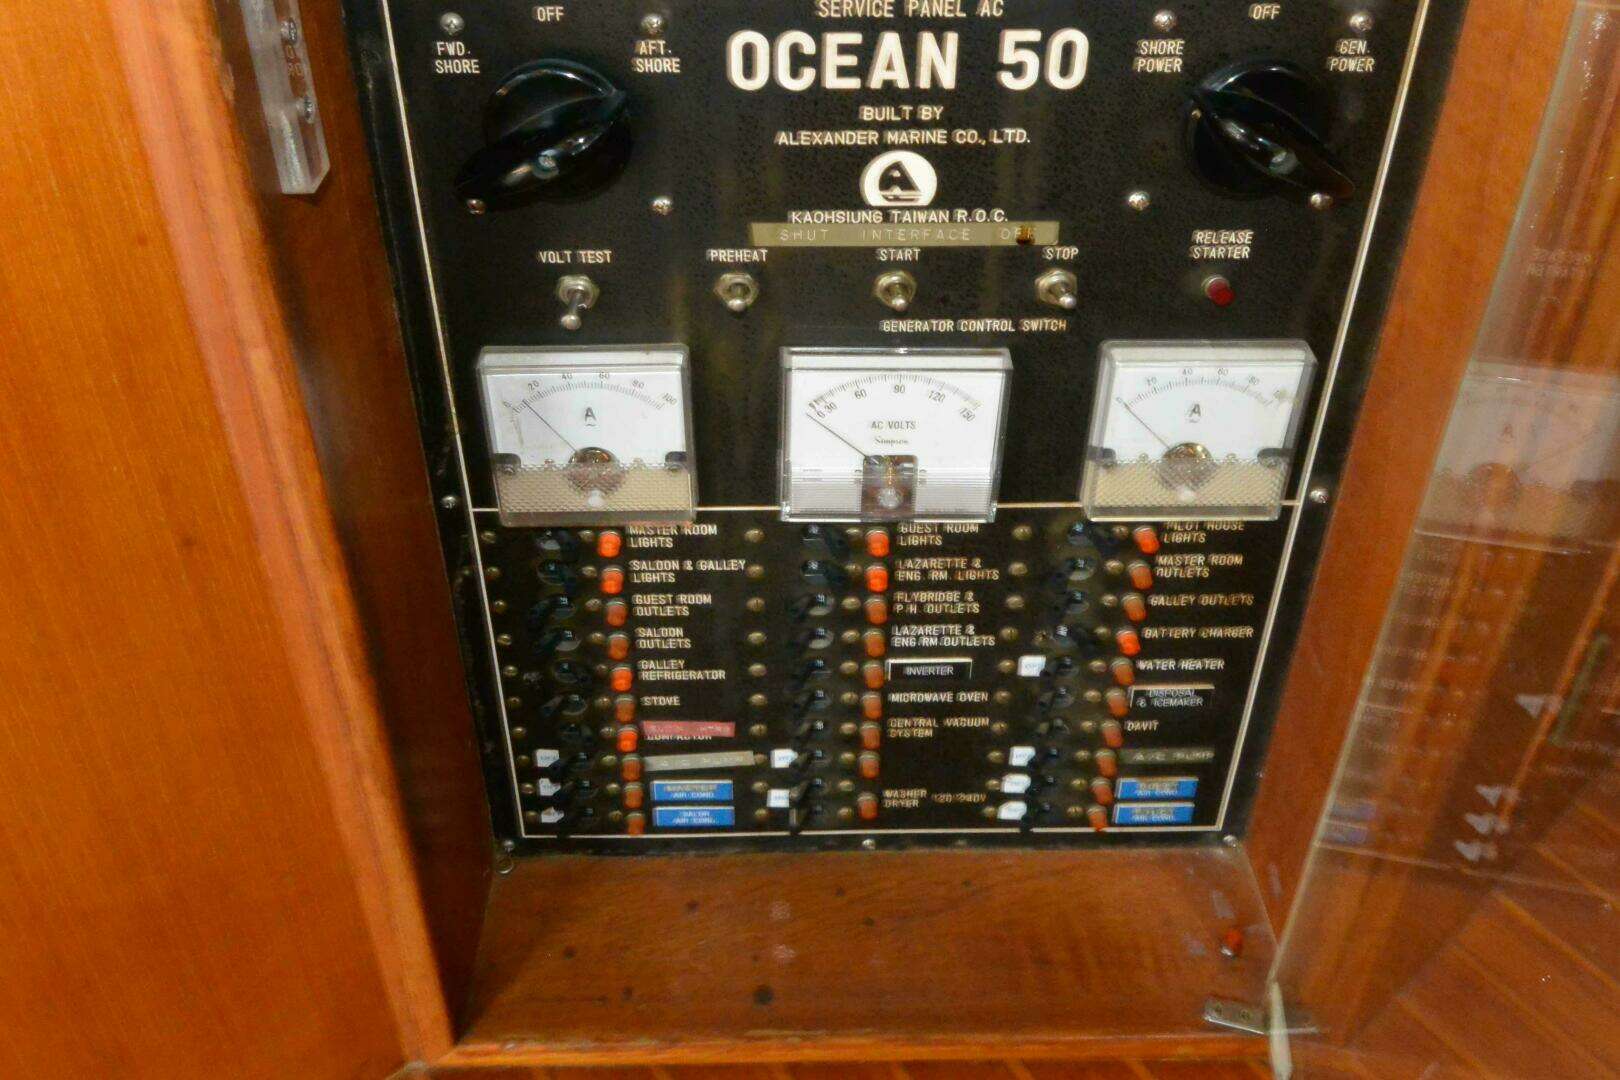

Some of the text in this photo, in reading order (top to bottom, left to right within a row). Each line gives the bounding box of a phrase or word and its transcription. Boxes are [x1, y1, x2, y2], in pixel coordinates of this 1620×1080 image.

[535, 6, 564, 22] OFF
[818, 0, 1004, 18] SERVICE PANEL AC
[1250, 5, 1281, 20] OFF
[435, 41, 471, 56] FWD.
[637, 40, 672, 55] AFT.
[1138, 40, 1184, 55] SHORE
[1337, 39, 1371, 55] GEN.
[633, 57, 681, 73] SHORE
[727, 28, 1090, 92] OCEAN 50
[1135, 58, 1183, 73] POWER
[1329, 57, 1375, 72] POWER
[435, 59, 481, 74] SHORE
[861, 106, 944, 121] BUILT BY
[775, 128, 1031, 145] ALEXANDER MARINE CO., LTD.
[789, 208, 1009, 224] KAOHSIUNG TAIWAN R.O.C.
[780, 229, 829, 242] SHUT
[862, 229, 972, 241] INTERFACE
[1192, 230, 1253, 244] RELEASE
[538, 250, 612, 264] VOLT TEST
[705, 249, 768, 263] PREHEAT
[876, 247, 921, 262] START
[1043, 246, 1079, 260] STOP
[1190, 246, 1250, 259] STARTER
[880, 319, 1067, 333] GENERATOR CONTROL SWITCH
[527, 379, 541, 392] 20
[854, 388, 868, 400] 60
[928, 389, 946, 403] 120
[583, 406, 597, 421] A
[871, 420, 916, 430] AC VOLTS
[683, 523, 718, 536] ROOM
[628, 536, 674, 548] LIGHTS
[898, 534, 943, 546] LIGHTS
[1162, 531, 1207, 543] LIGHTS
[630, 559, 746, 571] SALOON & GALLEY
[895, 557, 981, 569] LAZARETTE &
[1157, 553, 1243, 566] MASTER ROOM
[631, 571, 676, 583] LIGHTS
[954, 569, 1000, 580] LIGHTS
[1157, 566, 1210, 578] OUTLETS
[632, 594, 712, 604] GUEST ROOM
[965, 590, 974, 602] &
[1150, 593, 1254, 606] GALLEY OUTLETS
[633, 605, 690, 616] OUTLETS
[924, 602, 980, 614] OUTLETS
[635, 627, 684, 638] SALOON
[891, 624, 975, 636] LAZARETTE &
[1144, 626, 1254, 639] BATTERY CHARGER
[636, 638, 691, 649] OUTLETS
[943, 635, 996, 647] OUTLETS
[638, 660, 685, 670] GALLEY
[903, 666, 954, 675] INVERTER
[1137, 659, 1225, 670] WATER HEATER
[640, 669, 726, 680] REFRIGERATOR
[641, 696, 681, 706] STOVE
[889, 691, 989, 703] MICROWAVE OVEN
[1152, 697, 1204, 706] ICEMAKER
[888, 717, 990, 728] CENTRAL VACUUM
[1124, 720, 1159, 731] DAVIT
[888, 729, 933, 738] SYSTEM
[884, 789, 927, 799] WASHER
[884, 799, 919, 808] DRYER
